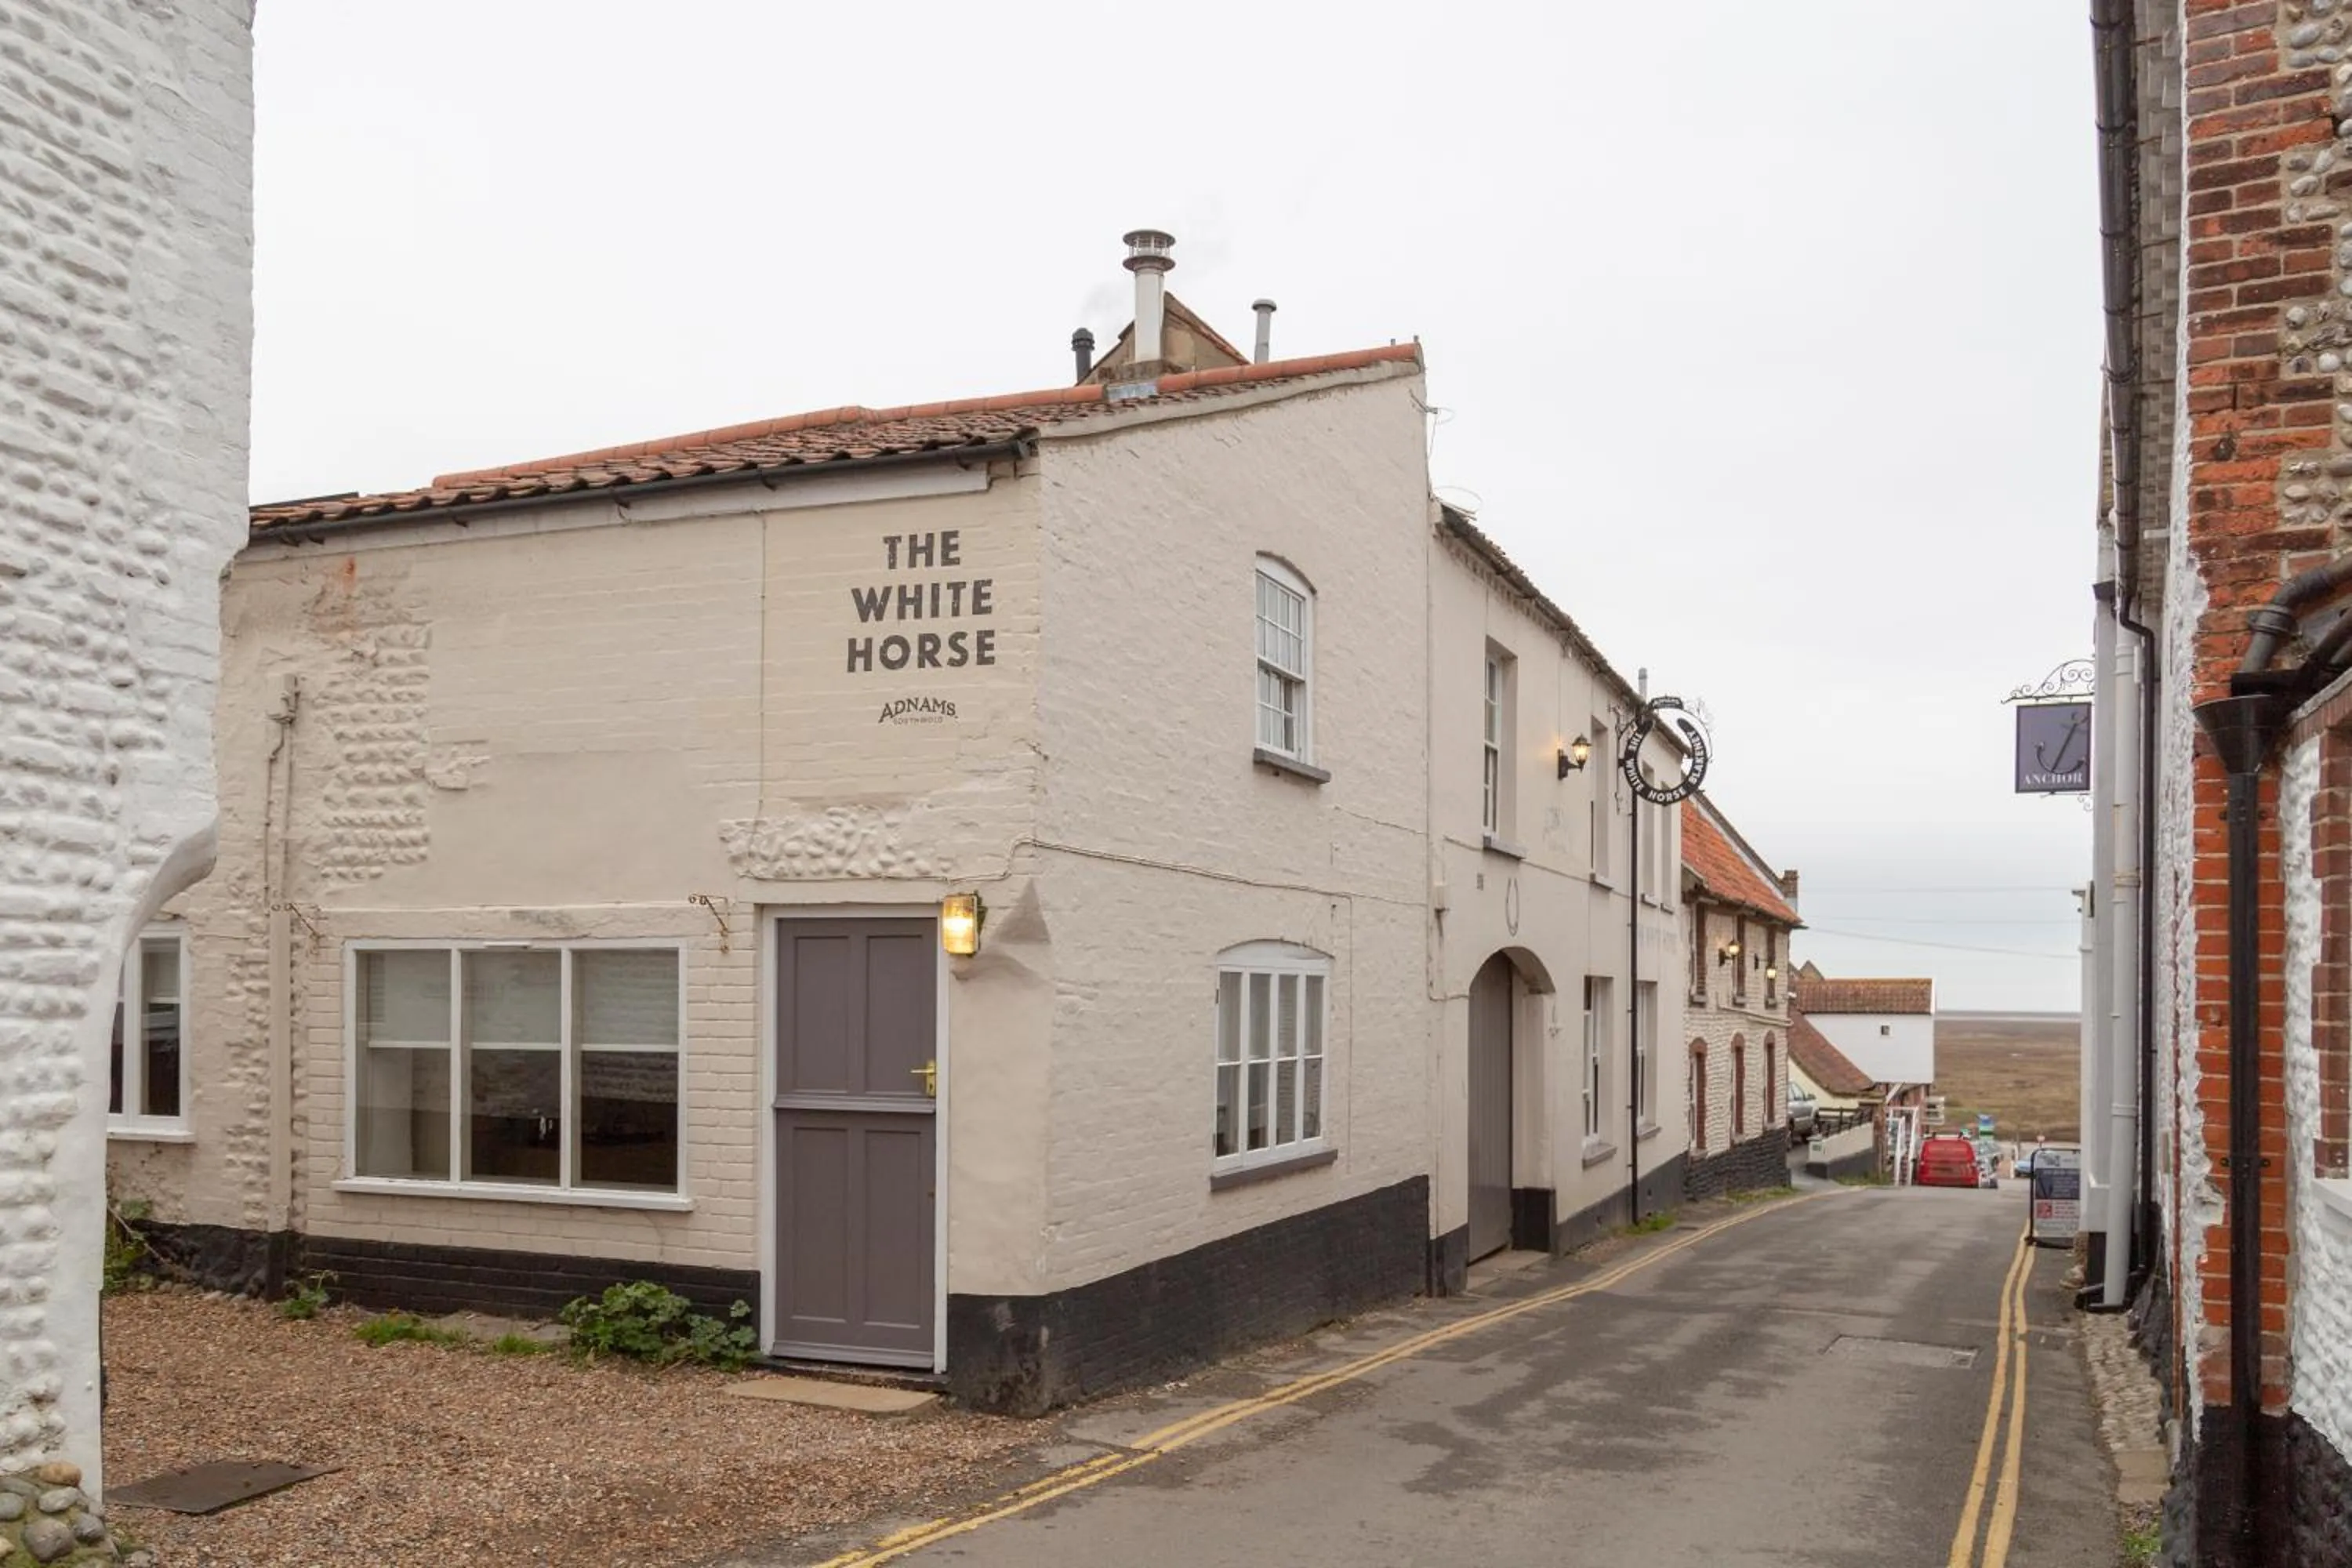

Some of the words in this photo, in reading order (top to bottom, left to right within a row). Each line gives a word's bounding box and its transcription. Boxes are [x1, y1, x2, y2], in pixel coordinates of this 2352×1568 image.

[883, 530, 960, 569] THE
[851, 579, 993, 622] WHITE
[847, 630, 995, 673] HORSE
[878, 696, 956, 723] ADNAMS
[1628, 732, 1643, 751] THE
[1687, 731, 1704, 785] BLAKENEY
[1625, 757, 1645, 792] WHITE
[2024, 773, 2084, 785] ANCHOR
[1647, 786, 1687, 802] HORSE
